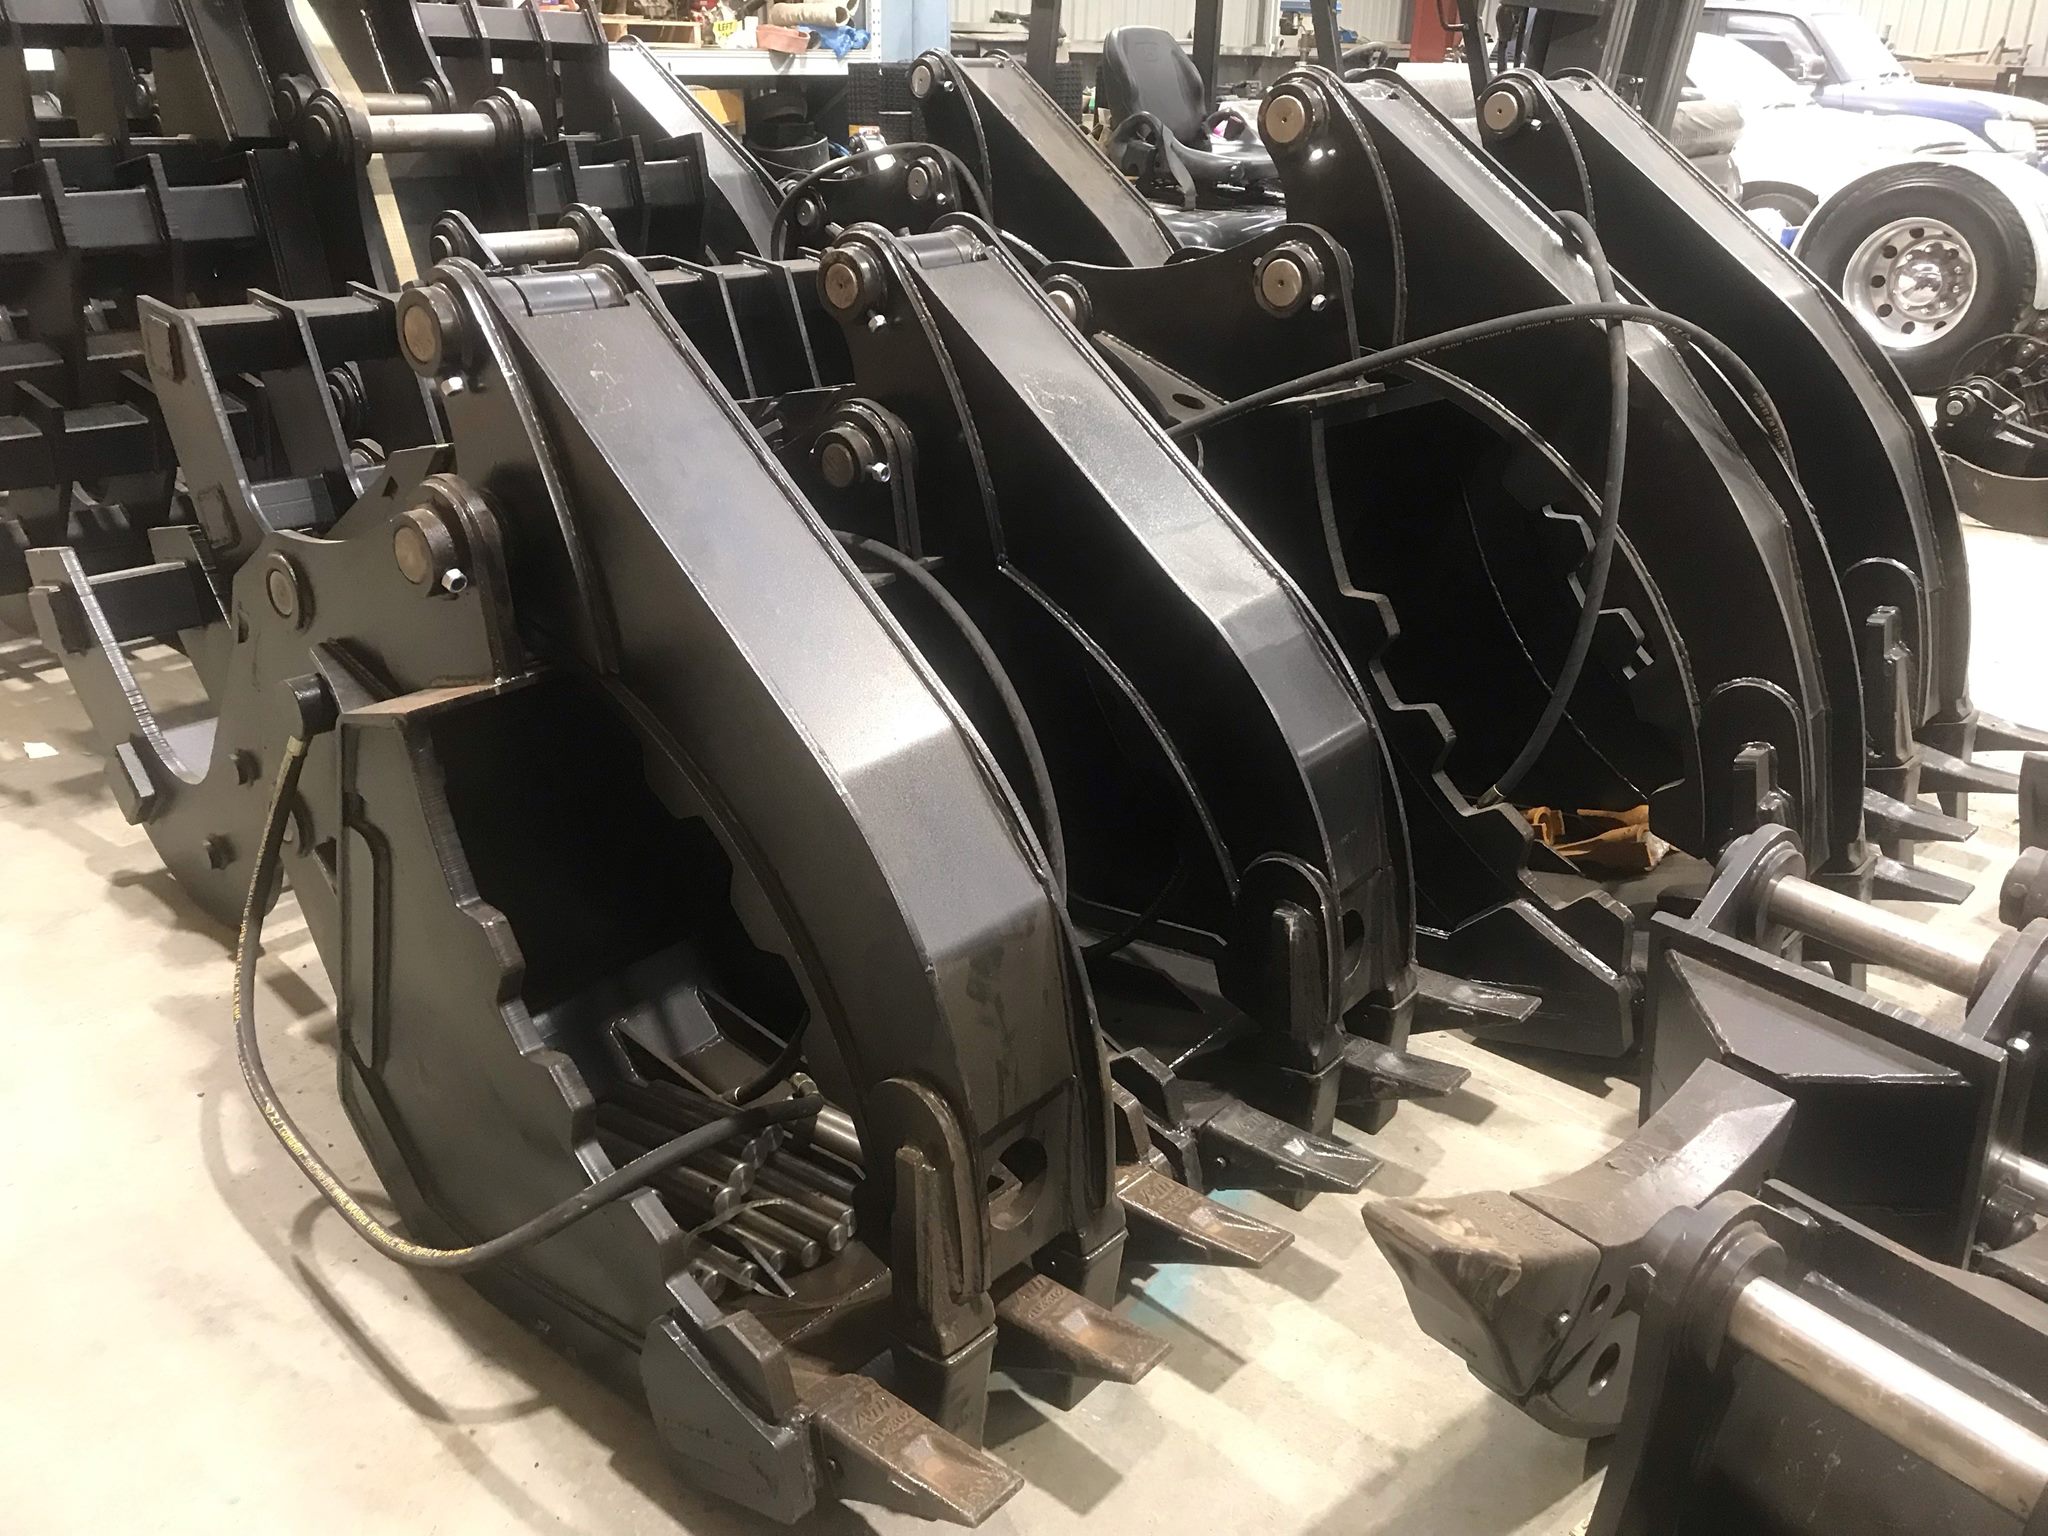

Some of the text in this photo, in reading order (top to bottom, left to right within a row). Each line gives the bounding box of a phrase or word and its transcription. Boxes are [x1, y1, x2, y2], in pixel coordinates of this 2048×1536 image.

[718, 22, 734, 32] LEFT
[331, 1185, 350, 1205] WIRE
[344, 1200, 370, 1226] BRAIDED
[366, 1221, 400, 1247] HYDRAULIC
